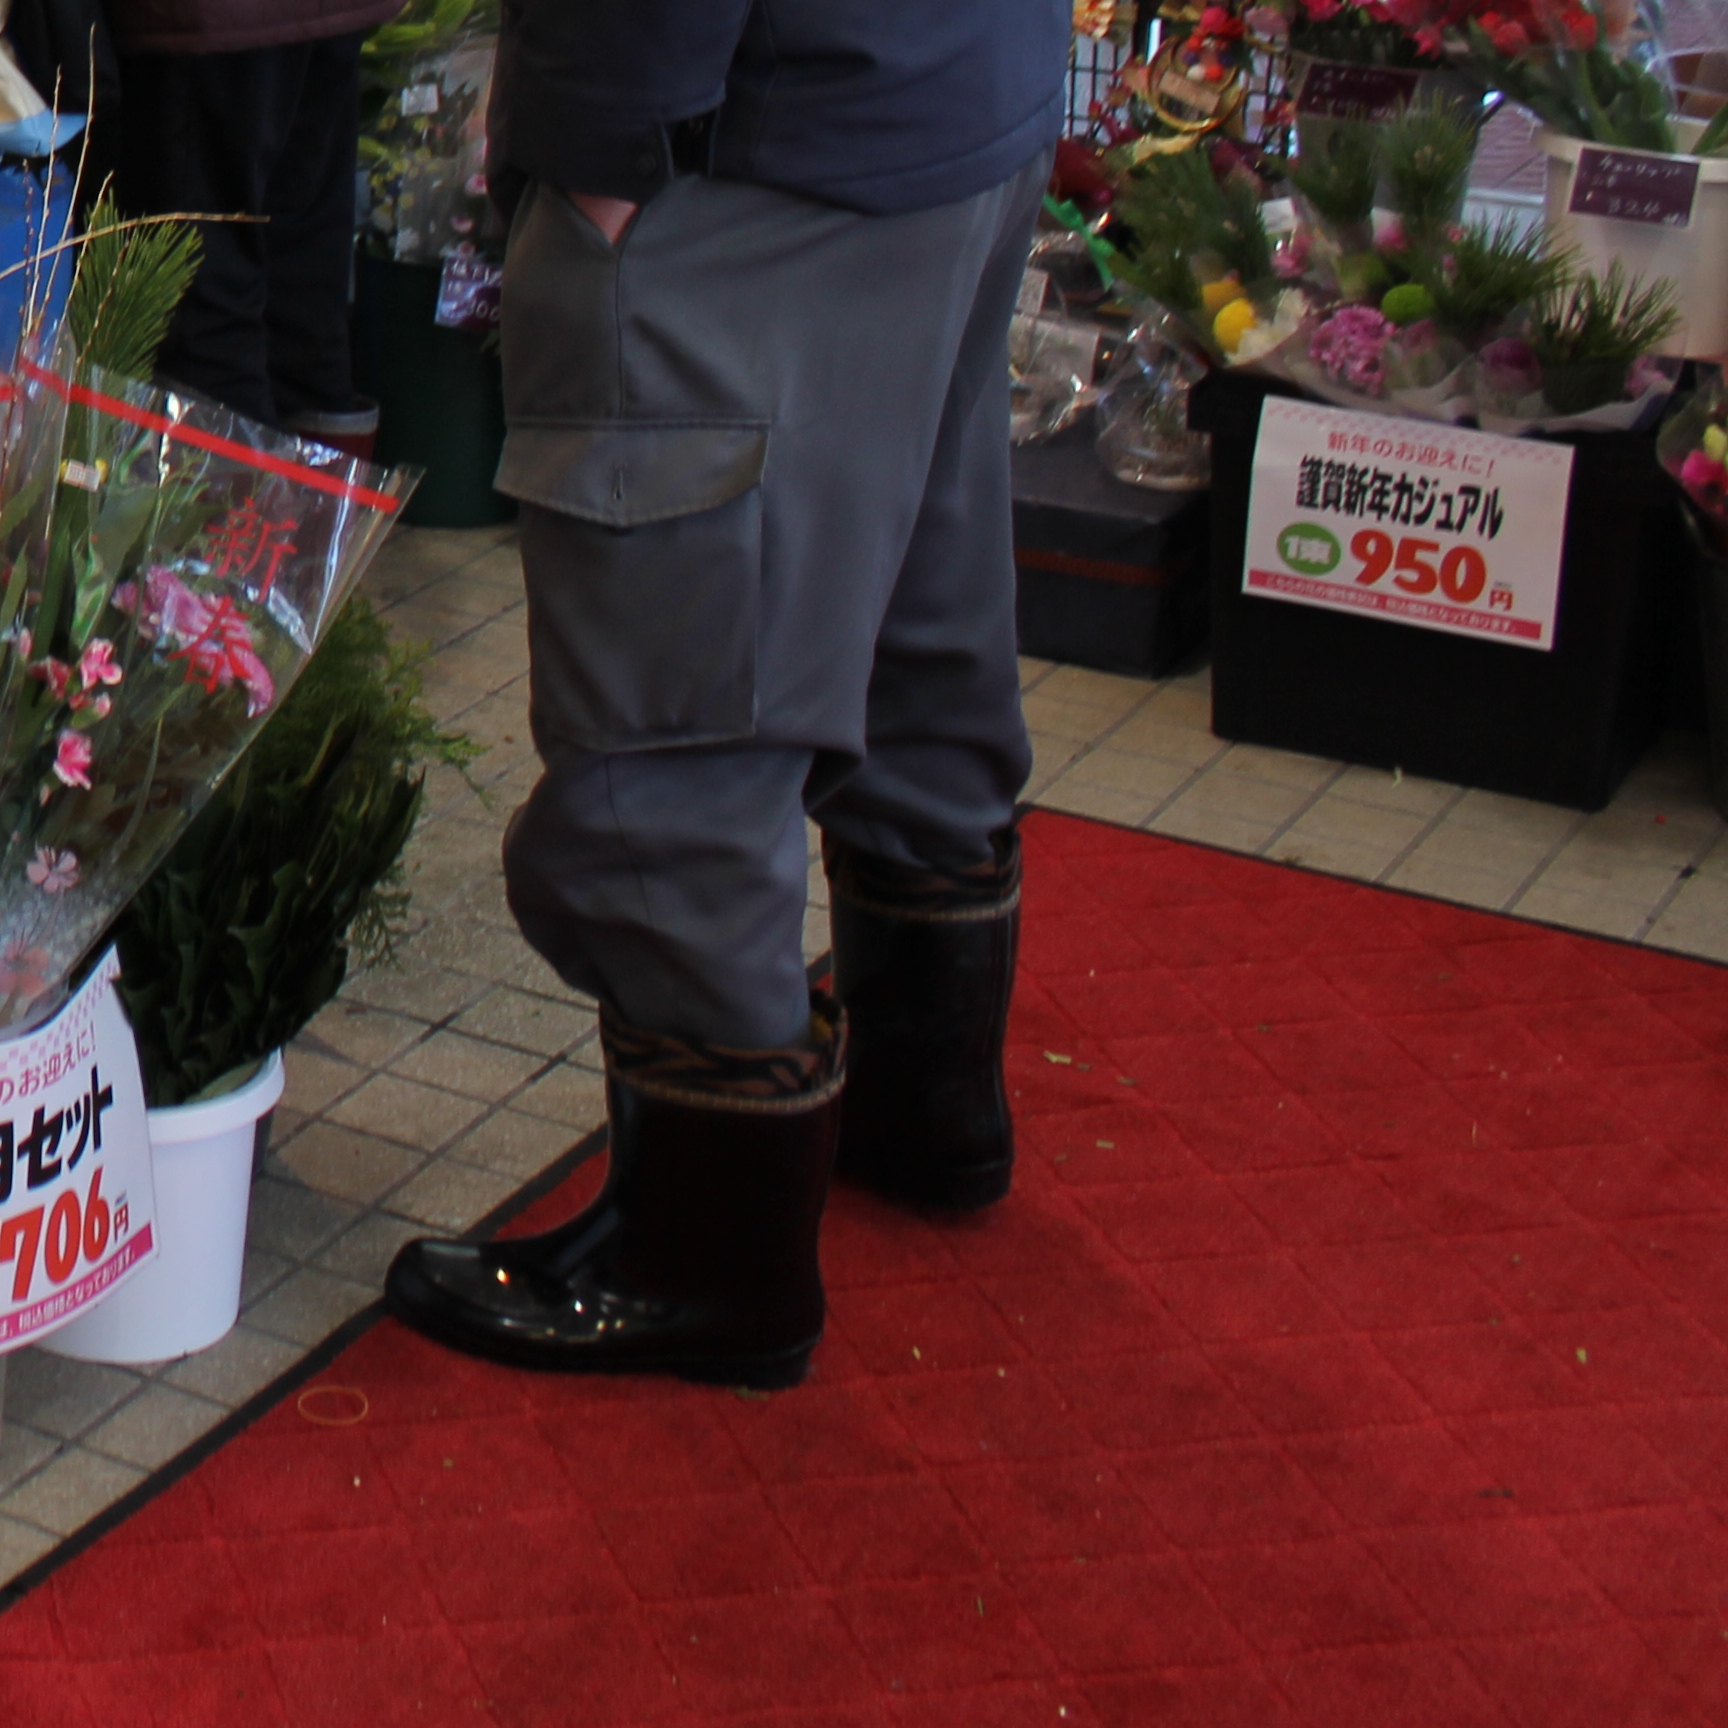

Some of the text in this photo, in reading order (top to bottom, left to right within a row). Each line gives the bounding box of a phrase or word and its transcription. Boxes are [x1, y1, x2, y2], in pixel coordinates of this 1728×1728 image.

[1327, 431, 1497, 478] 新年のお迎えに!
[1296, 454, 1504, 541] 謹賀新年カジュアル
